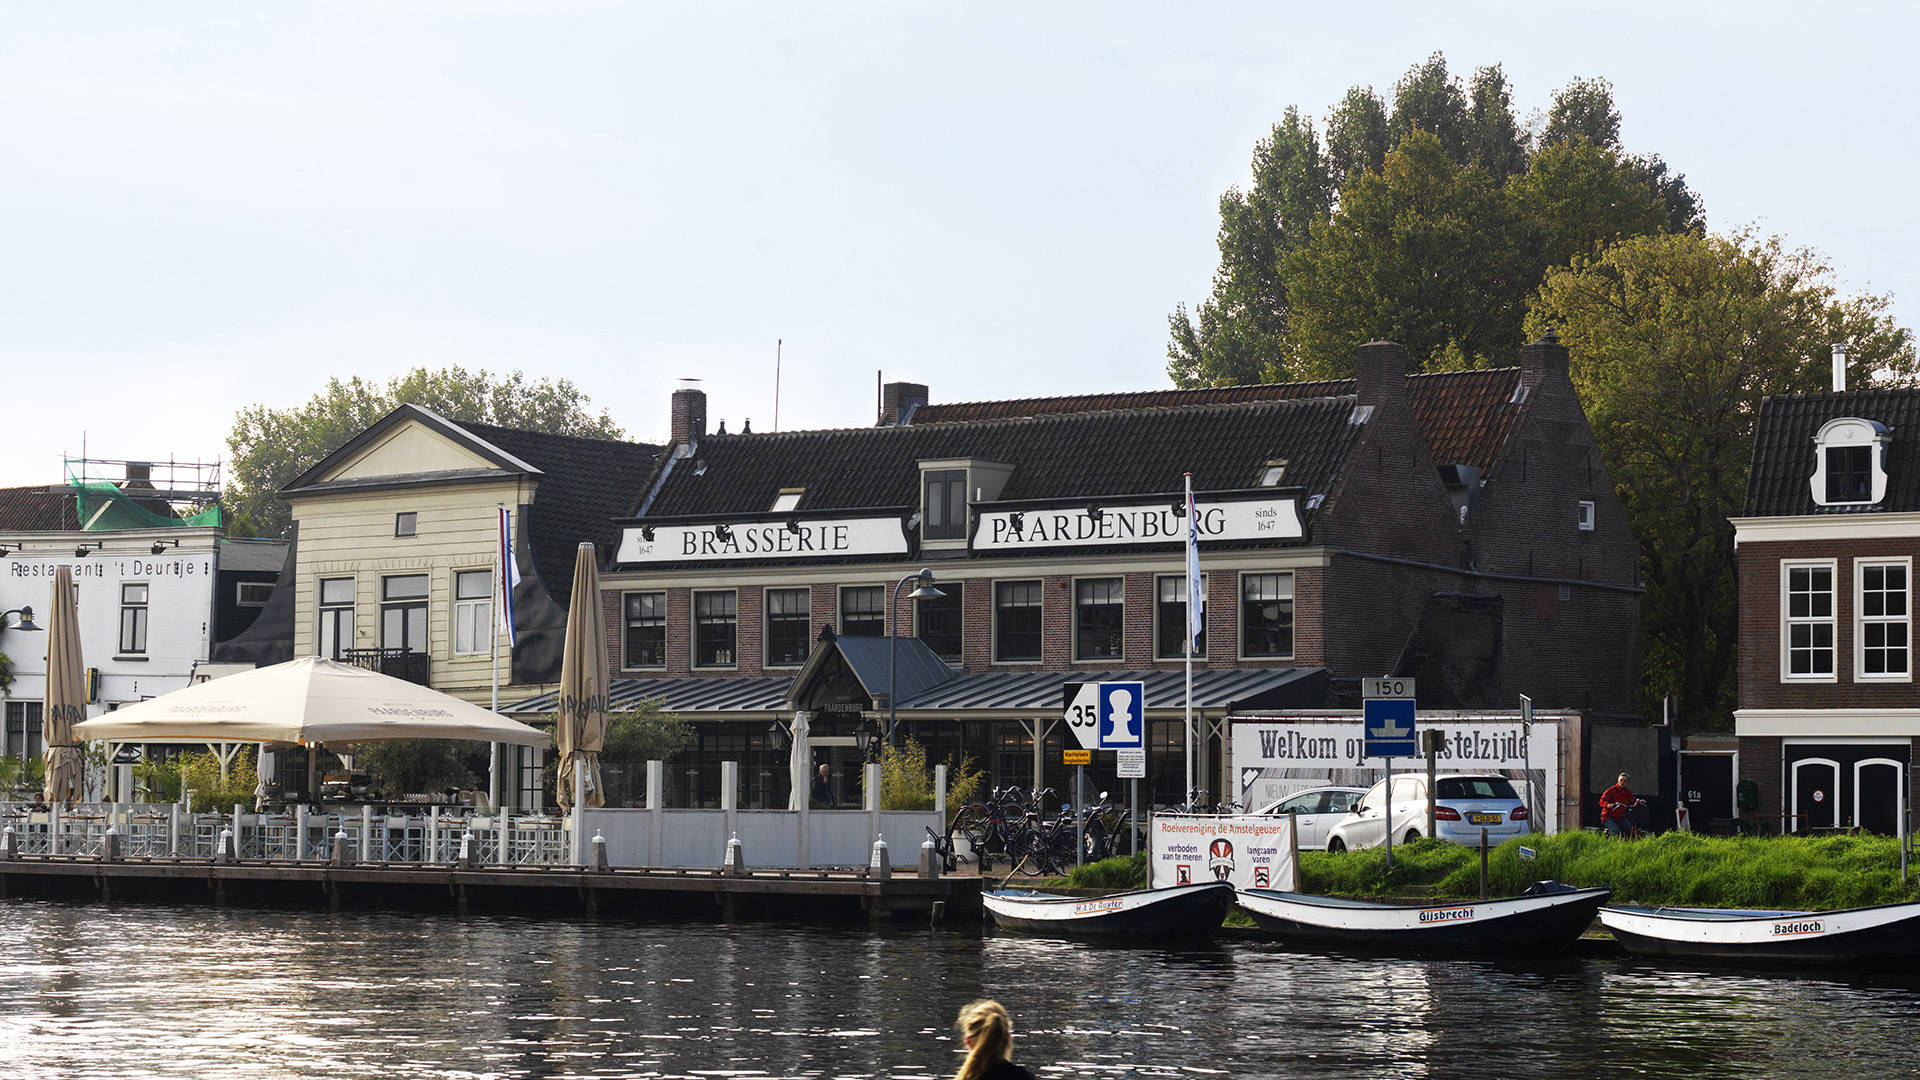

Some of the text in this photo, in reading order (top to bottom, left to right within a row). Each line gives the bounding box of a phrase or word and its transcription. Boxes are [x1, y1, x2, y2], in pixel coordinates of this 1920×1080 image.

[1254, 507, 1278, 518] sinds
[1257, 520, 1276, 531] 1647
[681, 525, 850, 555] BRASSERIE
[11, 561, 99, 577] Restaant
[1376, 681, 1404, 695] 150
[1071, 705, 1097, 728] 35
[1258, 730, 1338, 760] Welkom
[1688, 790, 1702, 799] 61a
[1161, 823, 1282, 836] Roeivereniging de Amstelgeuzen
[1167, 844, 1198, 852] verboden
[1246, 846, 1278, 856] langzaam
[1419, 908, 1474, 922] Gijsbrecht
[1774, 921, 1821, 934] Badeloch
